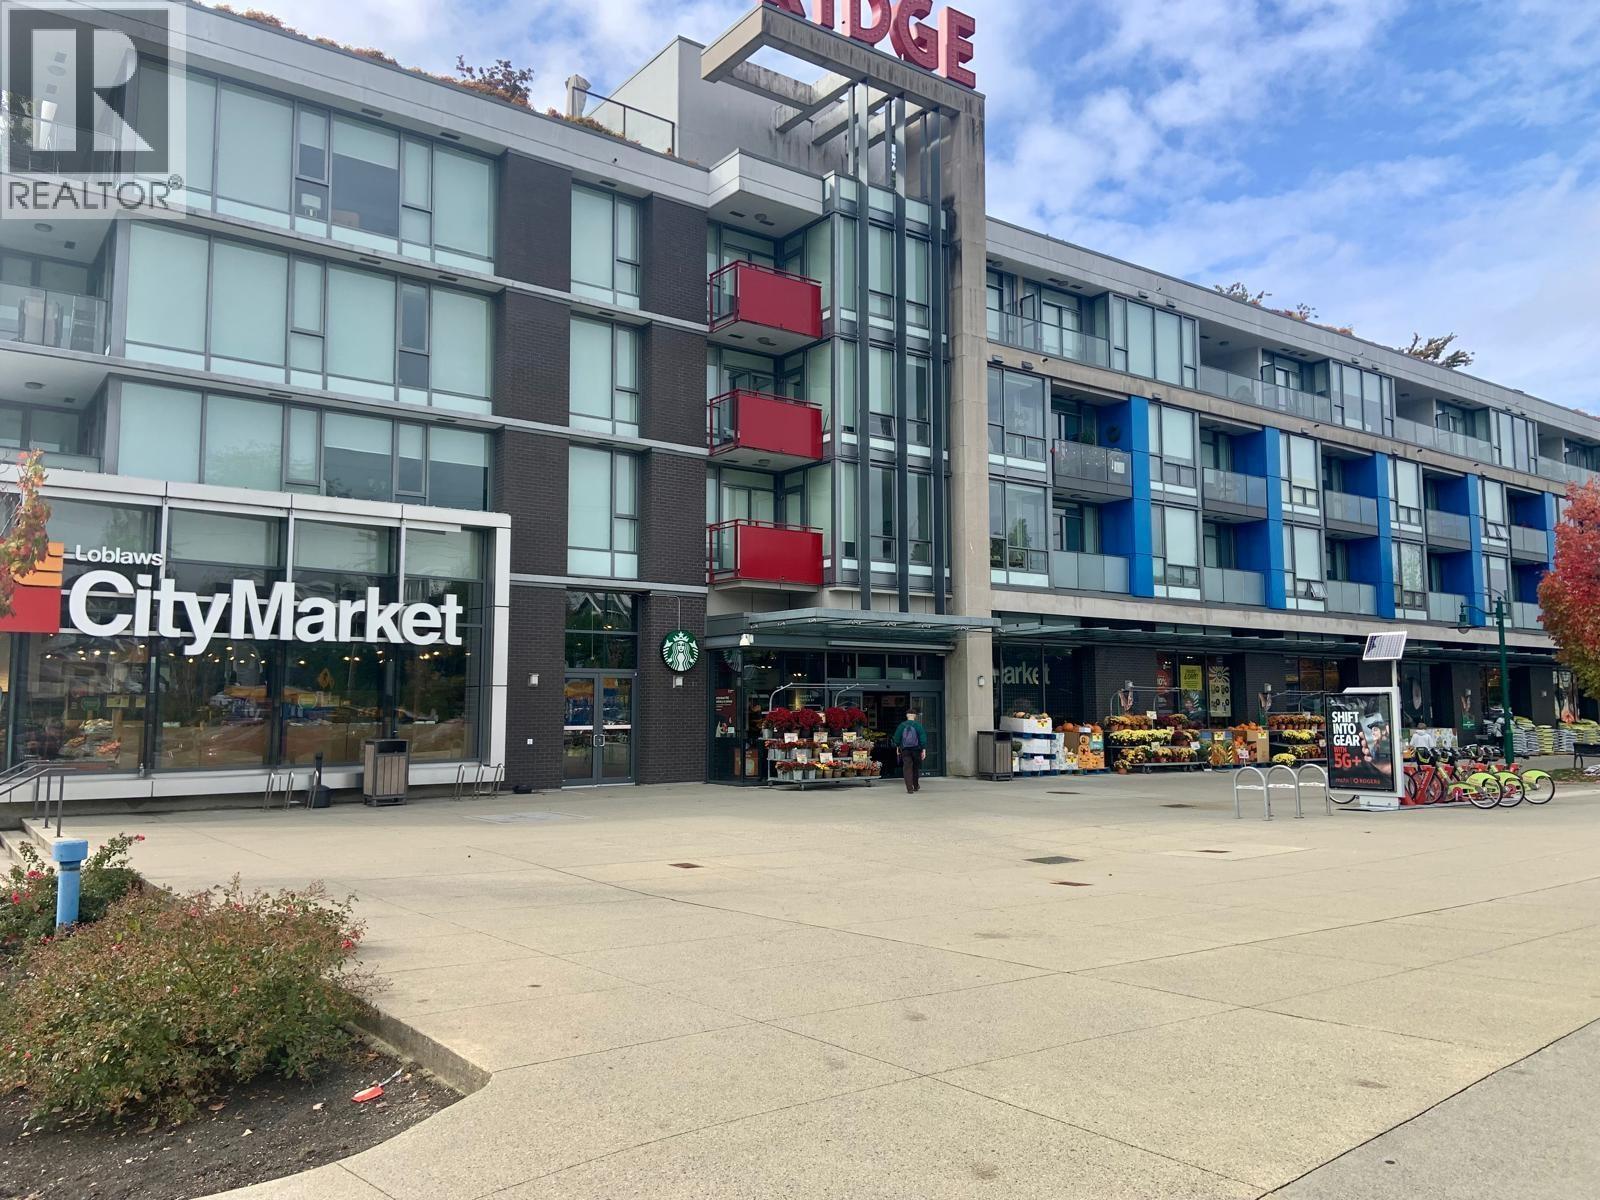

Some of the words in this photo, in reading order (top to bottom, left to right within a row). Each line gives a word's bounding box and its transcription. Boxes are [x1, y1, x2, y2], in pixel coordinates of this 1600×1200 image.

[762, 0, 976, 89] DGE
[75, 544, 163, 566] Loblaws
[68, 569, 463, 656] CityMarket
[1331, 711, 1359, 723] SHIFT
[1333, 723, 1356, 734] INTO
[1333, 734, 1360, 746] GEAR
[1334, 753, 1361, 768] 5G+
